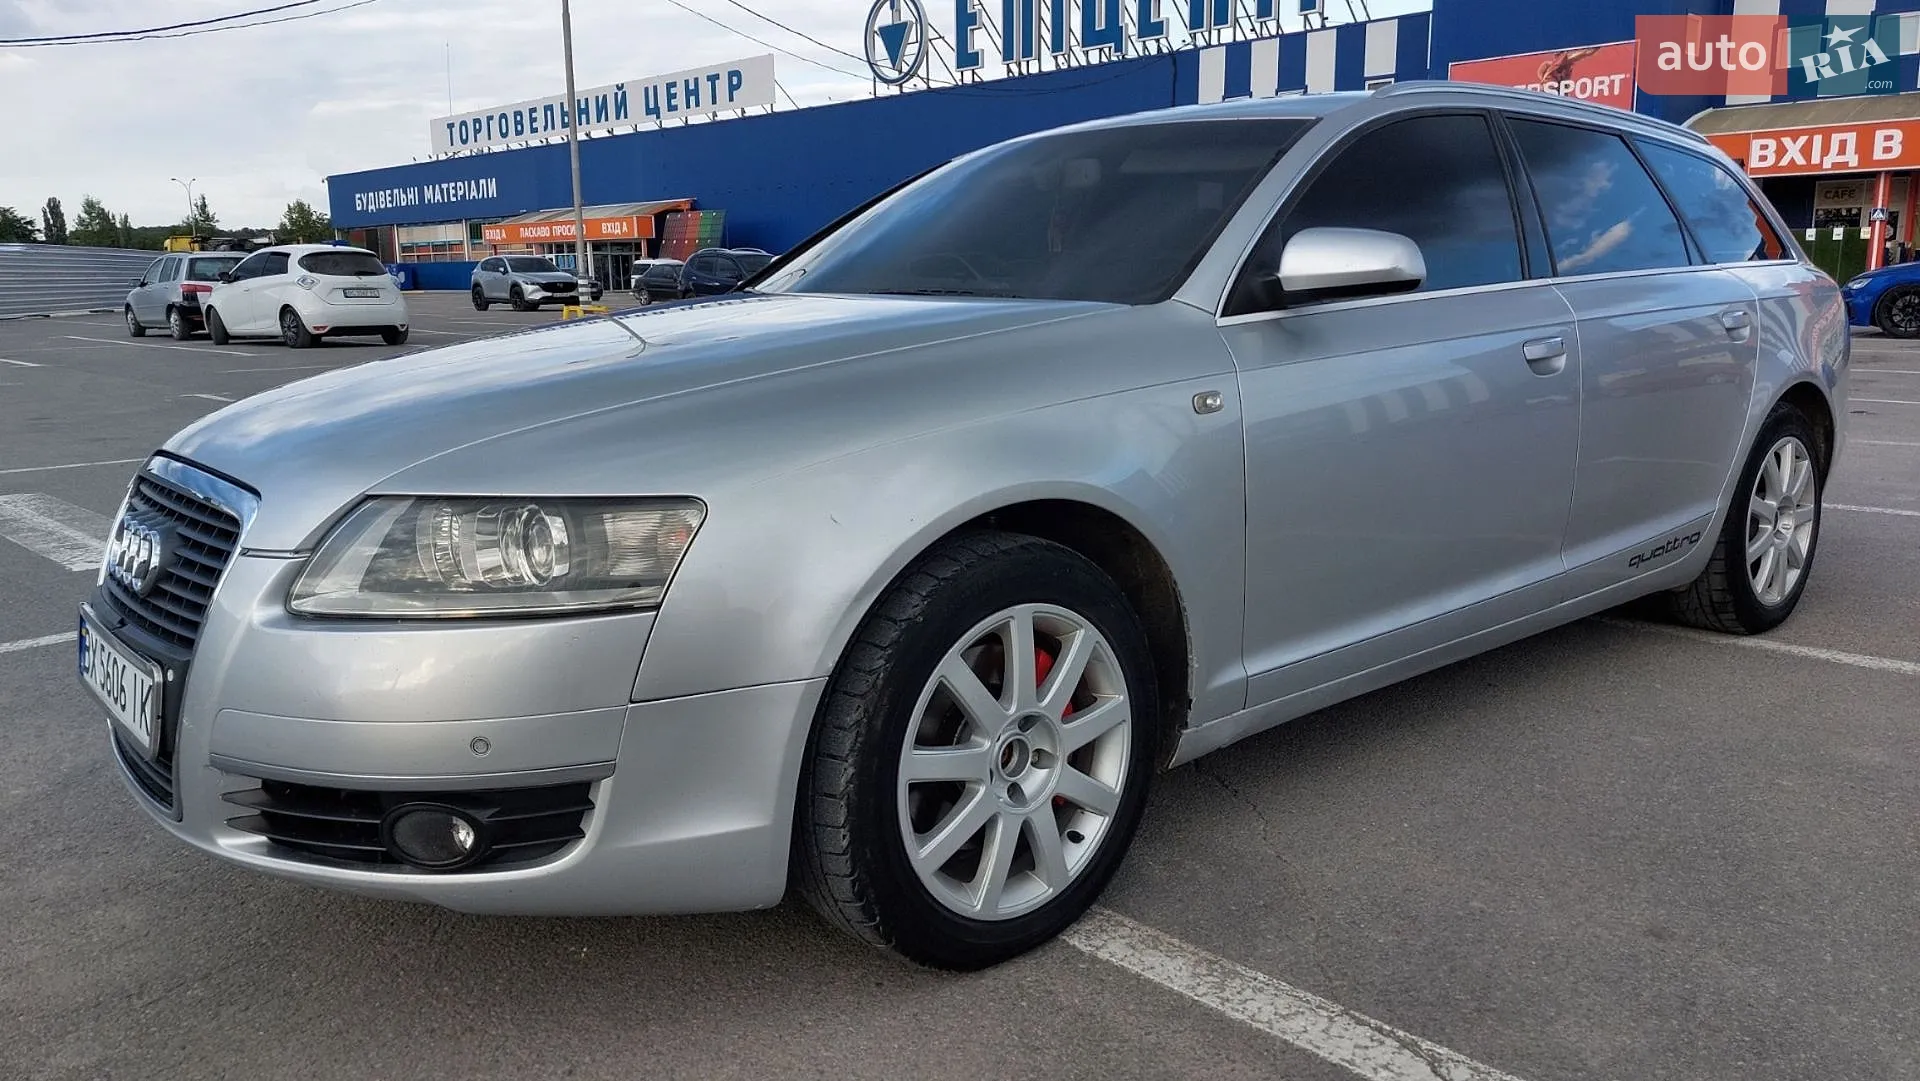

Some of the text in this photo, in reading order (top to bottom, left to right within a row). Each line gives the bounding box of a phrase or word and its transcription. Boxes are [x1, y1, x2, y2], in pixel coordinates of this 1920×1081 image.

[447, 69, 743, 146] ТОРГОВЕЛЬНИЙ ЦЕНТР
[1750, 129, 1903, 169] ВХІД В
[355, 177, 497, 213] БУДІВЕЛЬНІ МАТЕРІАЛИ
[552, 223, 587, 237] ПРОСИО
[601, 218, 628, 235] ВХІД А
[1628, 531, 1701, 568] quattro
[99, 643, 126, 713] 5606
[132, 672, 153, 736] IK
